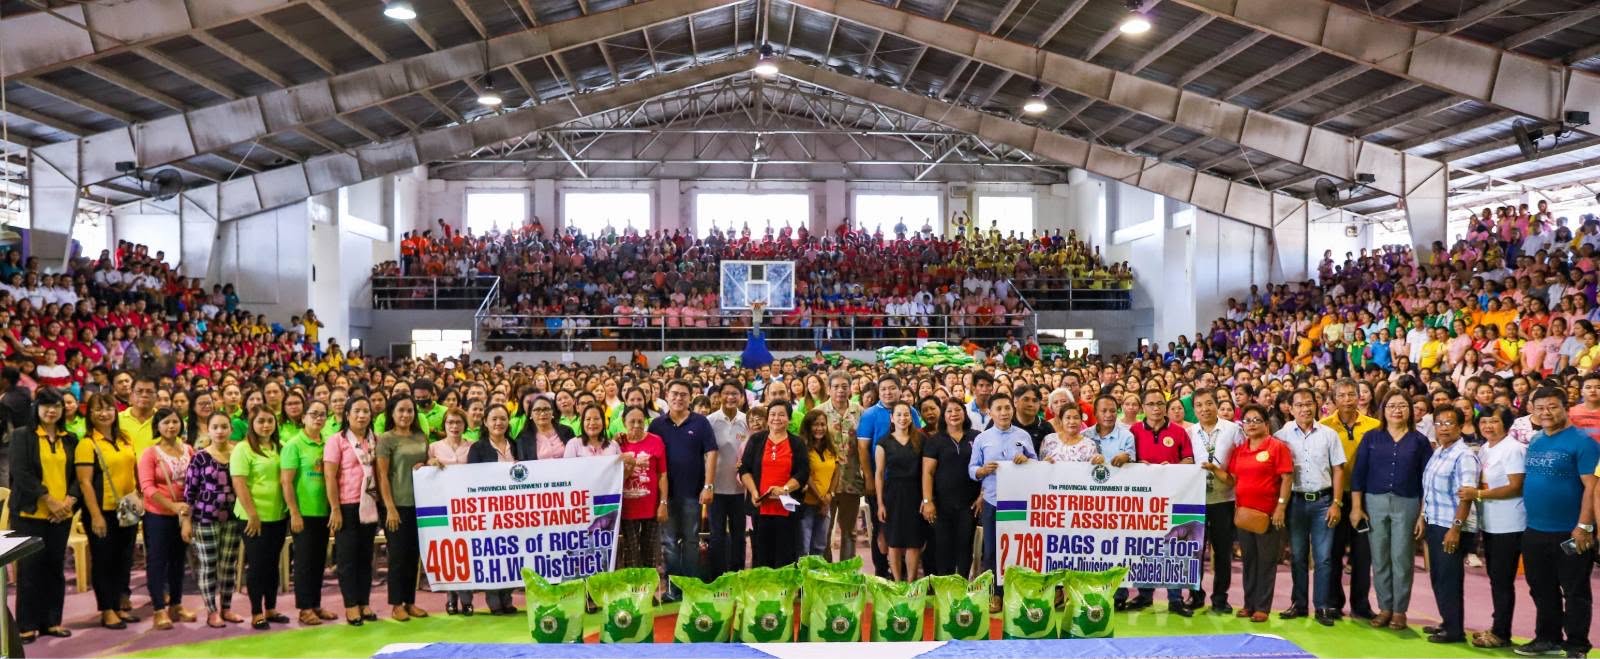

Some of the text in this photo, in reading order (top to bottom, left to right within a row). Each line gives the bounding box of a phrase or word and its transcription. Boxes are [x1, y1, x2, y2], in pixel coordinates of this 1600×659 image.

[509, 482, 542, 490] GOVERNMENT
[450, 490, 590, 515] DISTRIBUTION OF
[1030, 494, 1169, 513] DISTRIBUTION OF
[452, 507, 591, 532] RICE ASSISTANCE
[1029, 511, 1168, 531] RICE ASSISTANCE
[471, 535, 519, 557] BAGS
[525, 533, 543, 553] of
[549, 530, 589, 552] RICE
[1046, 534, 1199, 557] BAGS of RICE for
[426, 538, 471, 582] 409
[534, 550, 602, 578] District
[1128, 558, 1162, 582] Isabela
[1164, 559, 1186, 583] Dist.
[1189, 559, 1198, 584] III
